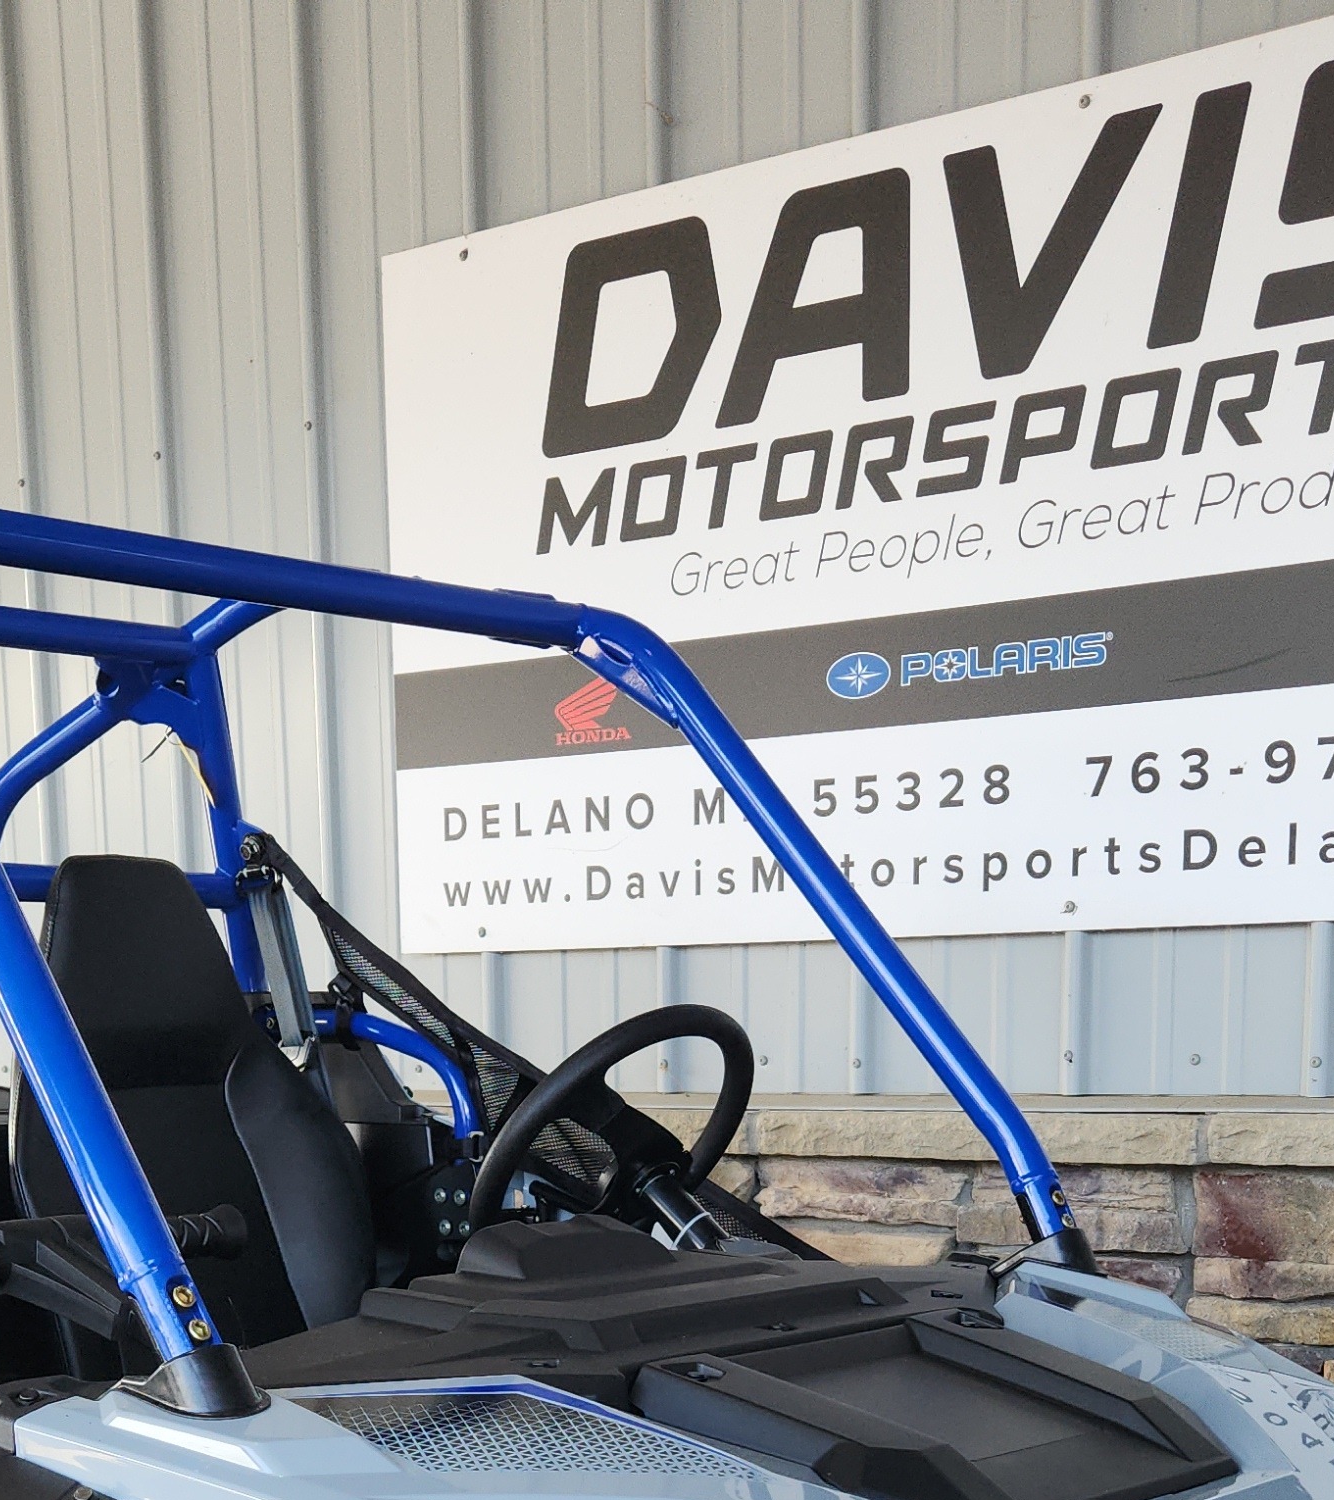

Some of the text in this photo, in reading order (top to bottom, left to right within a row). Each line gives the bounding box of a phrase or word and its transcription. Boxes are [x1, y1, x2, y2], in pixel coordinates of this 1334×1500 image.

[670, 541, 799, 596] Great
[816, 513, 993, 579] People,
[1017, 484, 1178, 549] Great
[555, 727, 632, 745] HONDA
[442, 793, 657, 843] DELANO
[813, 764, 1012, 817] 55328
